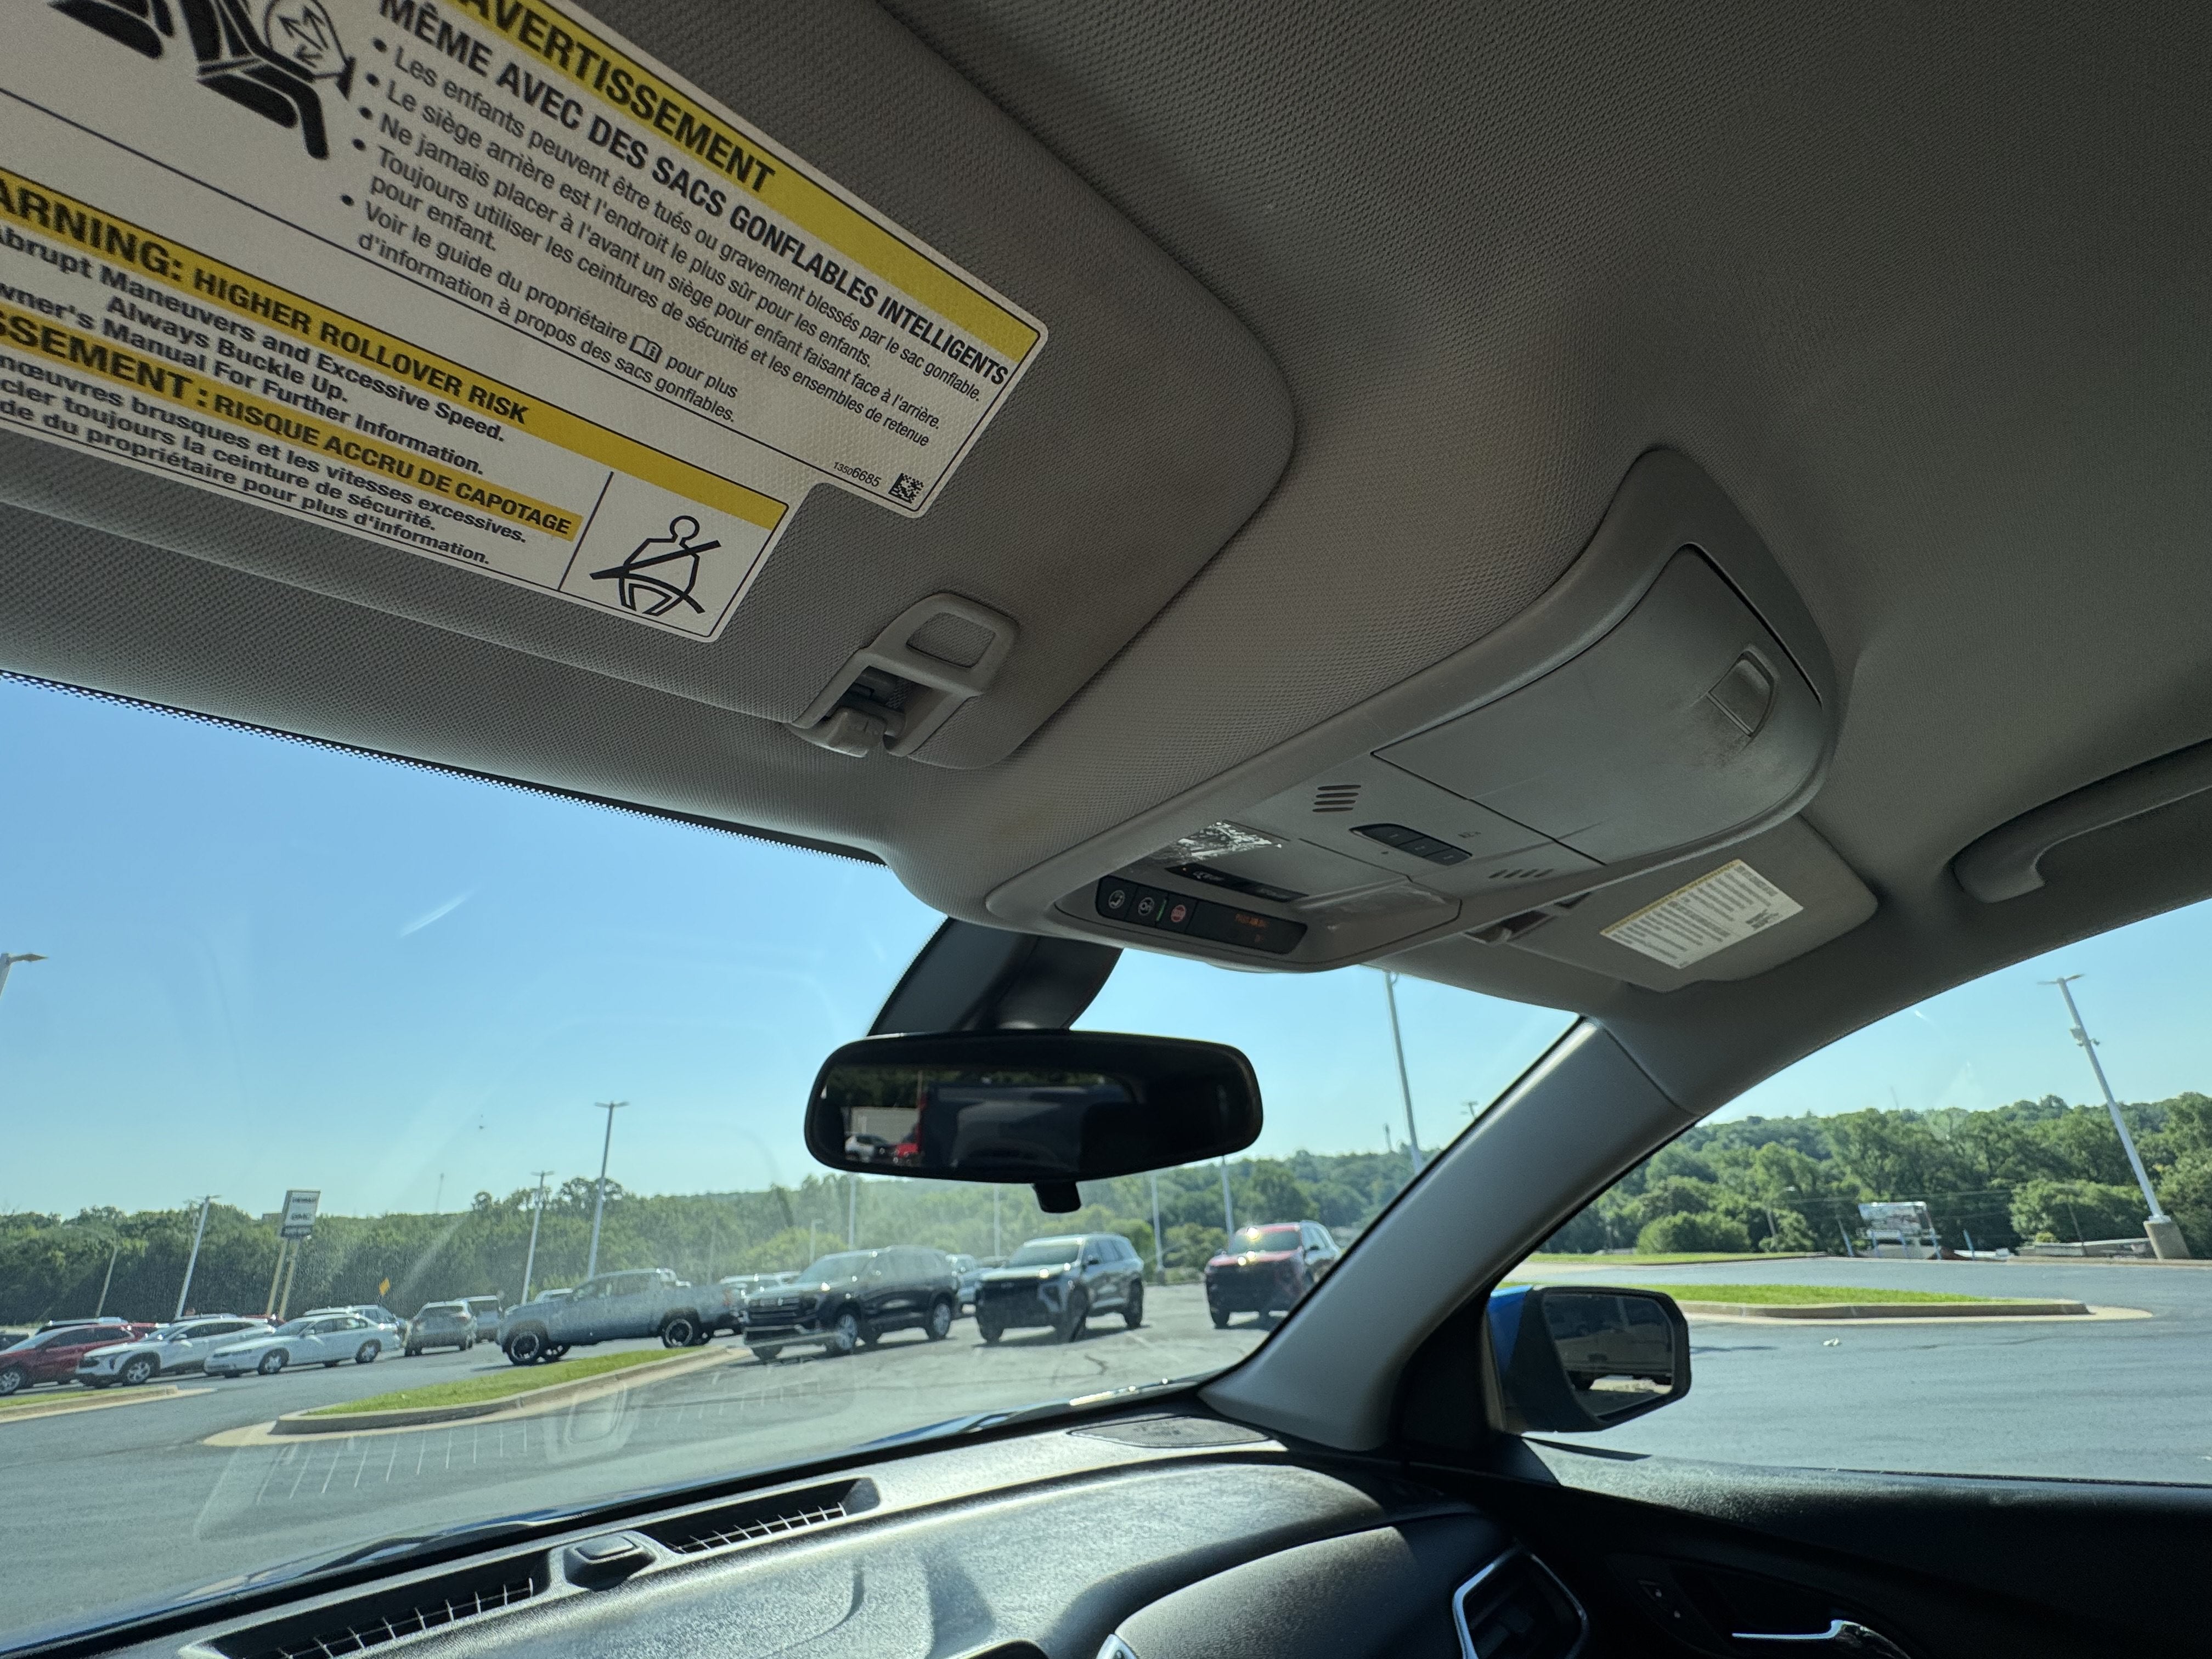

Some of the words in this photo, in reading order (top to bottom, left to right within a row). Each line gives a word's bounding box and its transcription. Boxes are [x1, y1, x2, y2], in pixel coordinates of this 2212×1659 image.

[458, 0, 776, 193] VERTISSEMENT
[370, 176, 423, 211] pour
[427, 205, 496, 251] enfant.
[379, 0, 493, 77] MÊME
[495, 61, 583, 130] AVEC
[587, 114, 648, 170] DES
[651, 156, 727, 217] SACS
[729, 205, 878, 308] GONFLABLES
[877, 296, 1009, 385] INTELLIGENTS
[380, 113, 413, 146] Ne
[415, 134, 489, 188] jamais
[493, 179, 558, 223] placer
[560, 212, 574, 234] à
[578, 222, 640, 269] l'avant
[642, 261, 665, 283] un
[668, 276, 713, 308] siège
[713, 302, 754, 329] pour
[754, 324, 803, 357] enfant
[803, 347, 851, 382] faisant
[851, 373, 881, 397] face
[880, 388, 891, 403] à
[891, 394, 939, 430] l'arrière.
[387, 80, 417, 112] Le
[422, 105, 482, 149] siège
[486, 142, 555, 189] arrière
[559, 183, 591, 210] est
[593, 198, 669, 254] l'endroit
[670, 242, 687, 264] le
[688, 257, 726, 286] plus
[727, 279, 757, 302] sûr
[755, 295, 794, 322] pour
[794, 313, 817, 336] les
[819, 330, 870, 368] enfants.
[394, 46, 437, 88] Les
[443, 80, 525, 138] enfants
[528, 130, 611, 188] peuvent
[612, 179, 650, 210] être
[653, 200, 692, 235] tués
[695, 229, 718, 251] ou
[719, 244, 805, 301] gravement
[805, 290, 860, 332] blessés
[858, 325, 887, 345] par
[885, 336, 900, 354] le
[899, 348, 925, 368] sac
[923, 362, 980, 402] gonflable.
[99, 264, 257, 343] Maneuvers
[262, 335, 311, 364] and
[316, 353, 430, 411] Excessive
[434, 402, 504, 442] Speed.
[106, 296, 210, 349] Always
[217, 337, 305, 385] Buckle
[311, 374, 348, 403] Up.
[193, 268, 312, 335] HIGHER
[319, 321, 463, 397] ROLLOVER
[467, 385, 529, 425] RISK
[358, 234, 494, 308] d'information
[498, 297, 511, 317] à
[514, 308, 577, 347] propos
[580, 340, 612, 364] des
[614, 357, 653, 383] sacs
[654, 377, 734, 422] gonflables.
[366, 201, 408, 235] Voir
[412, 225, 431, 248] le
[436, 241, 493, 278] guide
[497, 270, 522, 293] du
[525, 285, 628, 345] propriétaire
[665, 356, 704, 381] pour
[704, 375, 738, 398] plus
[379, 145, 469, 209] Toujours
[473, 202, 543, 246] utiliser
[545, 236, 574, 263] les
[577, 257, 658, 308] ceintures
[661, 301, 683, 321] de
[685, 315, 749, 355] sécurité
[750, 349, 768, 365] et
[768, 355, 791, 377] les
[792, 371, 865, 414] ensembles
[865, 407, 883, 423] de
[882, 417, 929, 447] retenue
[62, 396, 176, 445] toujours
[182, 435, 205, 456] la
[212, 449, 309, 489] ceinture
[315, 482, 342, 499] de
[347, 493, 435, 531] sécurité.
[102, 318, 207, 372] Manual
[213, 360, 257, 389] For
[262, 378, 351, 424] Further
[355, 414, 483, 475] Information.
[131, 396, 251, 450] brusques
[256, 443, 281, 460] et
[286, 450, 320, 473] les
[326, 465, 414, 505] vitesses
[417, 499, 526, 543] excessives.
[213, 393, 320, 447] RISQUE
[323, 435, 415, 479] ACCRU
[417, 468, 453, 493] DE
[455, 482, 572, 535] CAPOTAGE
[833, 461, 882, 487] 13506685
[42, 414, 78, 436] du
[87, 427, 237, 484] propriétaire
[242, 478, 297, 503] pour
[301, 496, 348, 520] plus
[353, 513, 489, 565] d'information.
